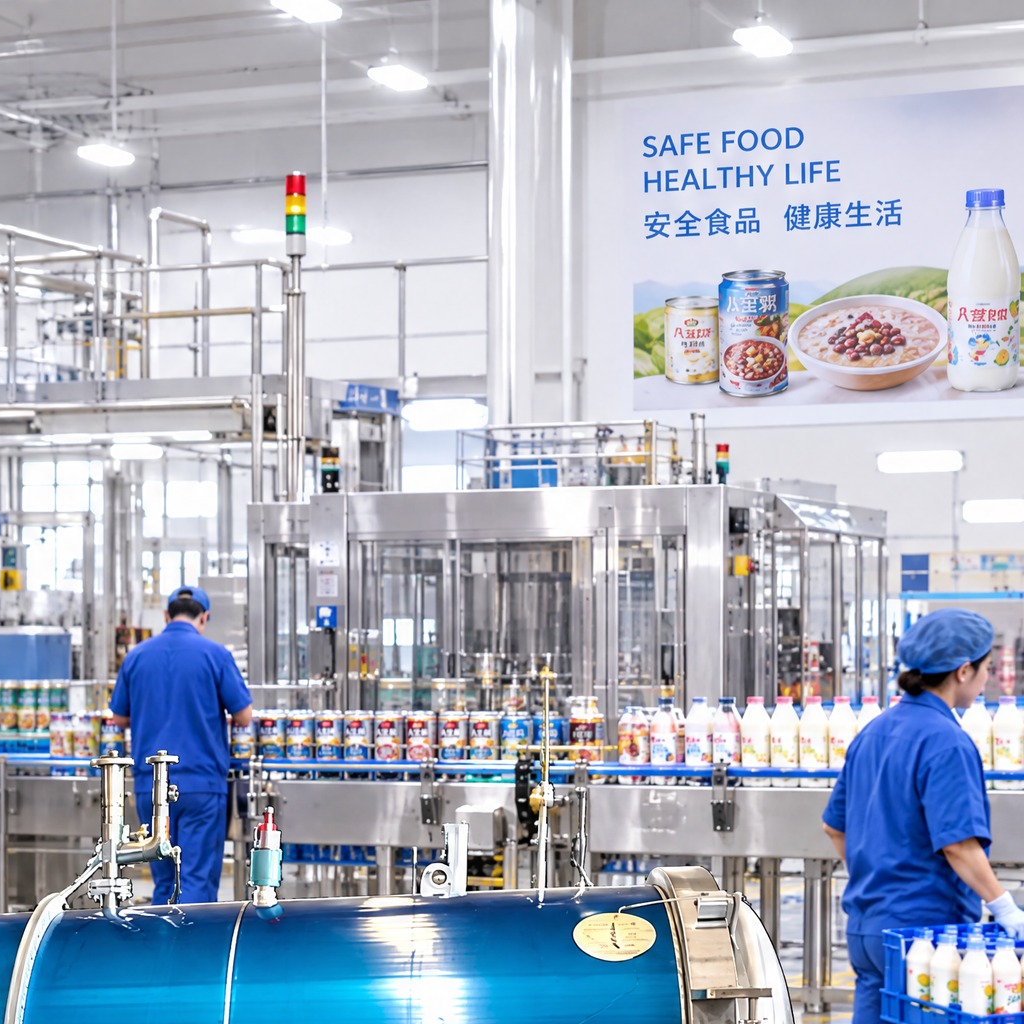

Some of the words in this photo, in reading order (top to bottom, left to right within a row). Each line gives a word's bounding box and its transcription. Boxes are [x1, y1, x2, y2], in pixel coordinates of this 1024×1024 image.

[642, 132, 711, 158] SAFE
[721, 126, 805, 154] FOOD
[643, 163, 775, 193] HEALTHY
[785, 159, 842, 185] LIFE
[644, 206, 762, 240] 安全食品
[784, 198, 904, 232] 健康生活
